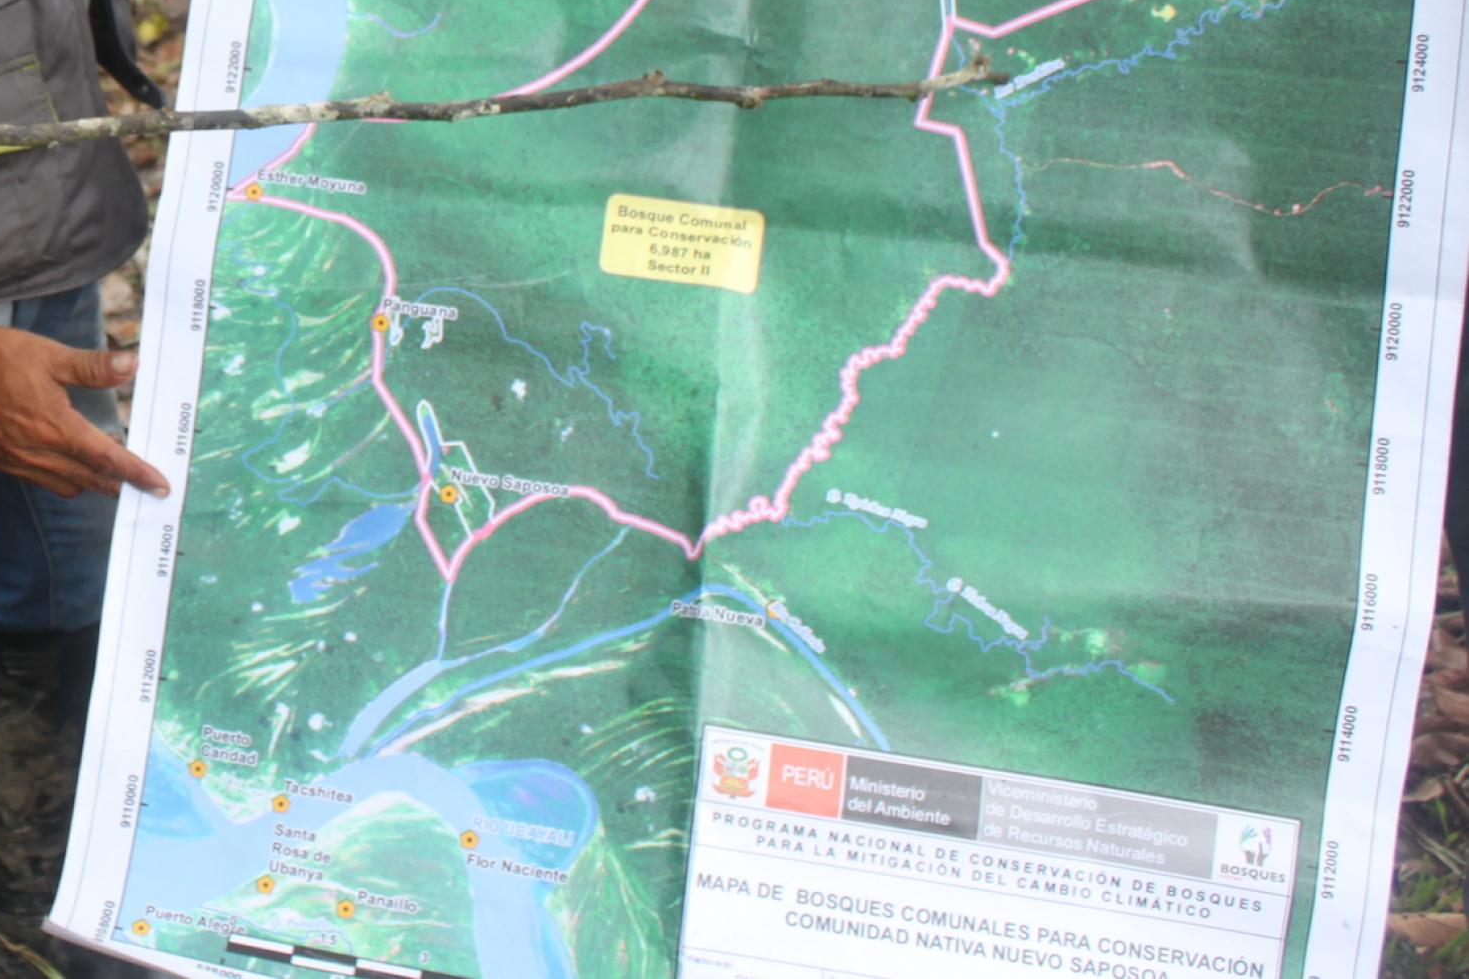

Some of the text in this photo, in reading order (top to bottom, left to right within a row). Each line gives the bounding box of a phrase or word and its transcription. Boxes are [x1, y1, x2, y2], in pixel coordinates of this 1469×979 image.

[225, 41, 242, 94] 9122000
[1412, 33, 1430, 93] 9124000
[206, 160, 225, 212] 9120000
[257, 168, 366, 196] Esther Moyuna
[1397, 169, 1415, 228] 9122000
[618, 204, 747, 231] Bosque Comunal
[611, 223, 752, 249] para Conservación
[647, 260, 697, 276] Sector
[693, 246, 711, 260] ha
[190, 279, 206, 331] 9118000
[383, 298, 457, 321] Panguana
[1385, 302, 1403, 361] 9120000
[175, 402, 192, 455] 9116000
[1372, 437, 1390, 495] 9118000
[451, 469, 569, 498] Nuevo Saposoa
[157, 524, 174, 577] 9114000
[714, 606, 764, 628] Nueva
[1361, 573, 1379, 631] 9116000
[140, 649, 156, 702] 9112000
[202, 726, 251, 747] Puerto
[1337, 705, 1358, 763] 9114000
[284, 781, 353, 804] Tacshitea
[781, 764, 836, 791] PERÚ
[849, 775, 926, 802] Ministerio
[121, 774, 139, 828] 9110000
[848, 796, 951, 826] del Ambiente
[987, 781, 1098, 812] Viceministerio
[274, 824, 317, 842] Santa
[985, 802, 1189, 849] de Desarrollo Estratégico
[271, 842, 331, 863] Rosa de
[983, 822, 1166, 866] de Recursos Naturales
[269, 861, 324, 882] Ubanya
[467, 853, 568, 883] Flor Naciente
[712, 811, 1263, 913] PROGRAMA NACIONAL DE CONSERVACIÓN DE BOSQUES
[756, 834, 804, 854] PARA
[814, 842, 836, 859] LA
[847, 848, 962, 880] MITIGACIÓN
[972, 869, 1006, 888] DEL
[1017, 875, 1092, 900] CAMBIO
[1220, 863, 1286, 884] BOSQUES
[1321, 840, 1339, 900] 9112000
[146, 905, 192, 925] Puerto
[358, 890, 417, 913] Panaillo
[697, 872, 1265, 979] MAPA DE BOSQUES COMUNALES PARA CONSERVACIÓN
[785, 911, 910, 946] COMUNIDAD
[916, 931, 987, 958] NATIVA
[992, 944, 1064, 971] NUEVO
